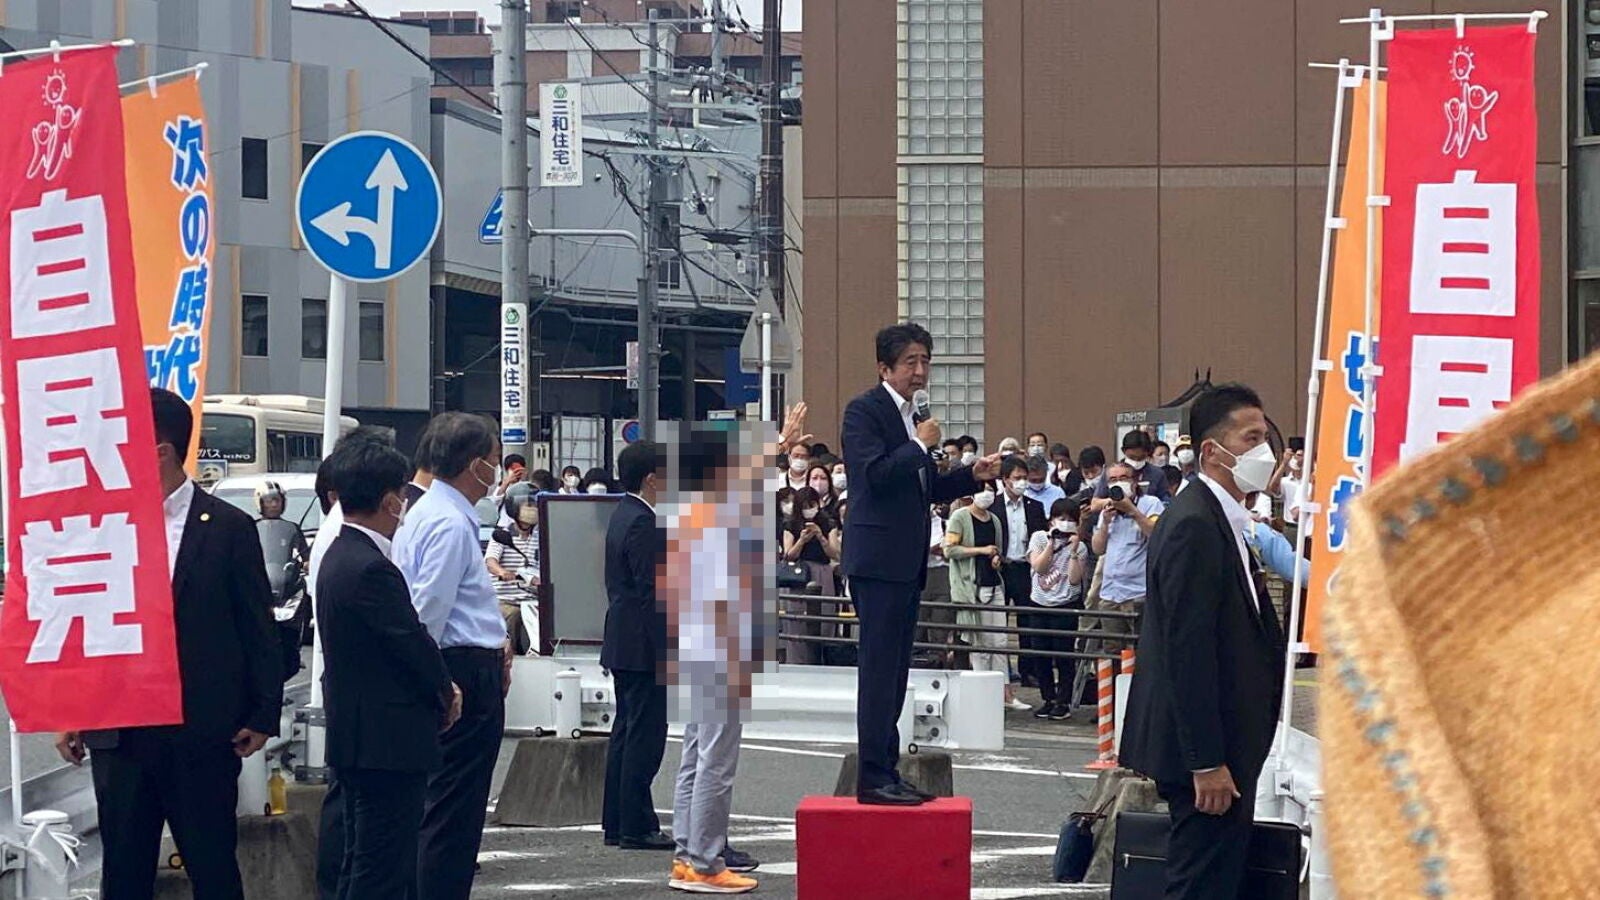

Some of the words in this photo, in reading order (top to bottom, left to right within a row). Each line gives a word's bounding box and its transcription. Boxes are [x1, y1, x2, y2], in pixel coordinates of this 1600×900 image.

[552, 100, 569, 165] 三和住宅
[164, 116, 208, 405] 次の時代
[9, 188, 144, 664] 自民党
[504, 326, 520, 408] 三和住宅
